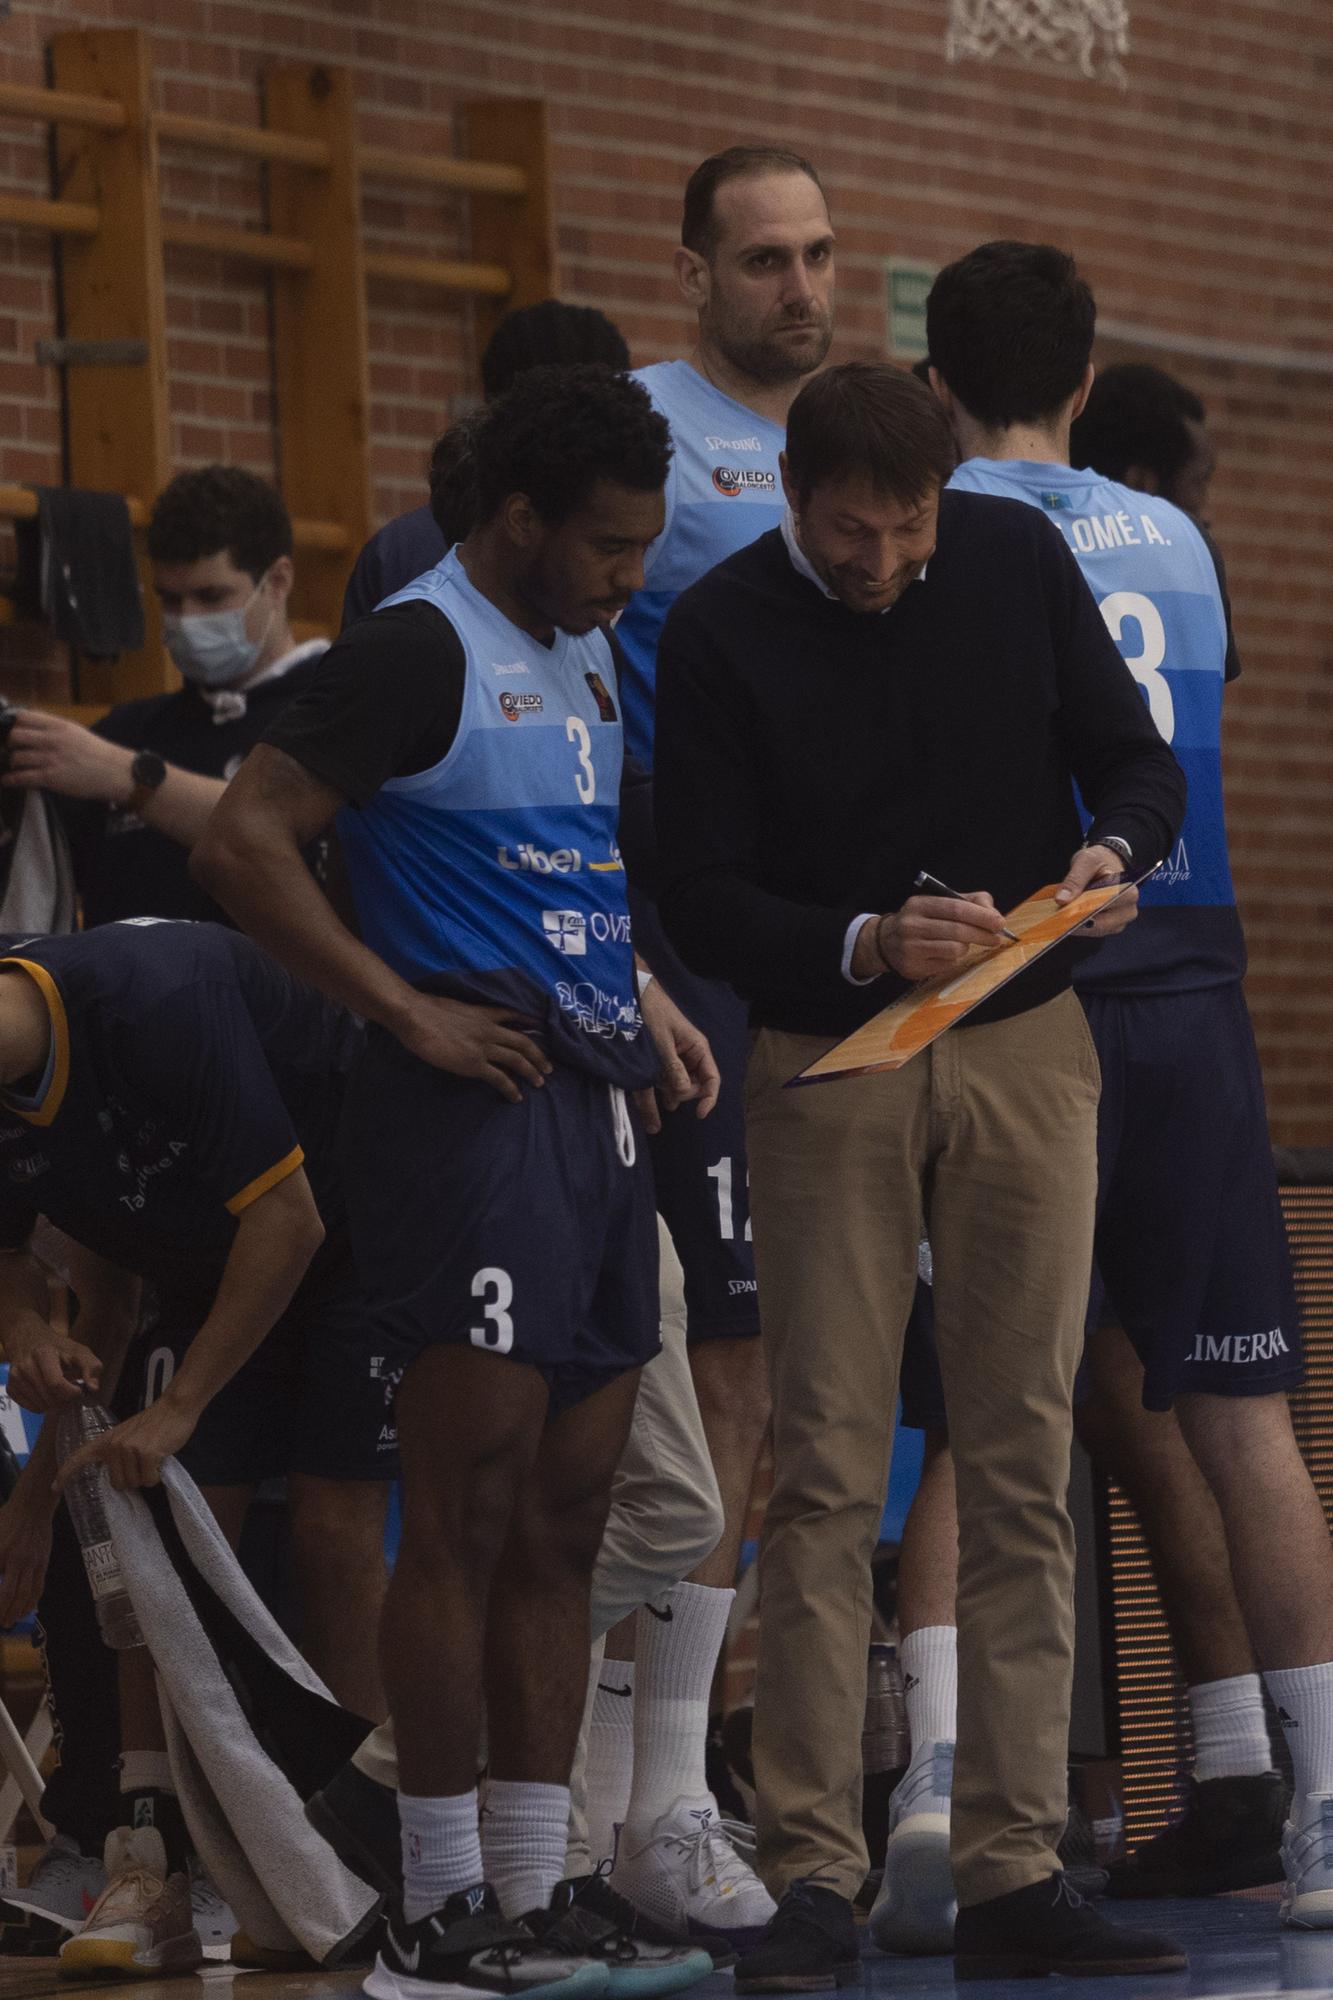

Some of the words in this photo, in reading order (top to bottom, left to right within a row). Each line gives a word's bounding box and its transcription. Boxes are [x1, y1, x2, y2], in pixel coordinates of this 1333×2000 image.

[705, 436, 762, 452] SPADING
[721, 470, 775, 483] OVIEDO
[1141, 514, 1173, 547] A.
[504, 695, 543, 706] OVIEDO
[566, 716, 596, 805] 3
[707, 1156, 753, 1242] 1
[470, 1267, 514, 1354] 3
[1183, 1326, 1290, 1363] IMERKA
